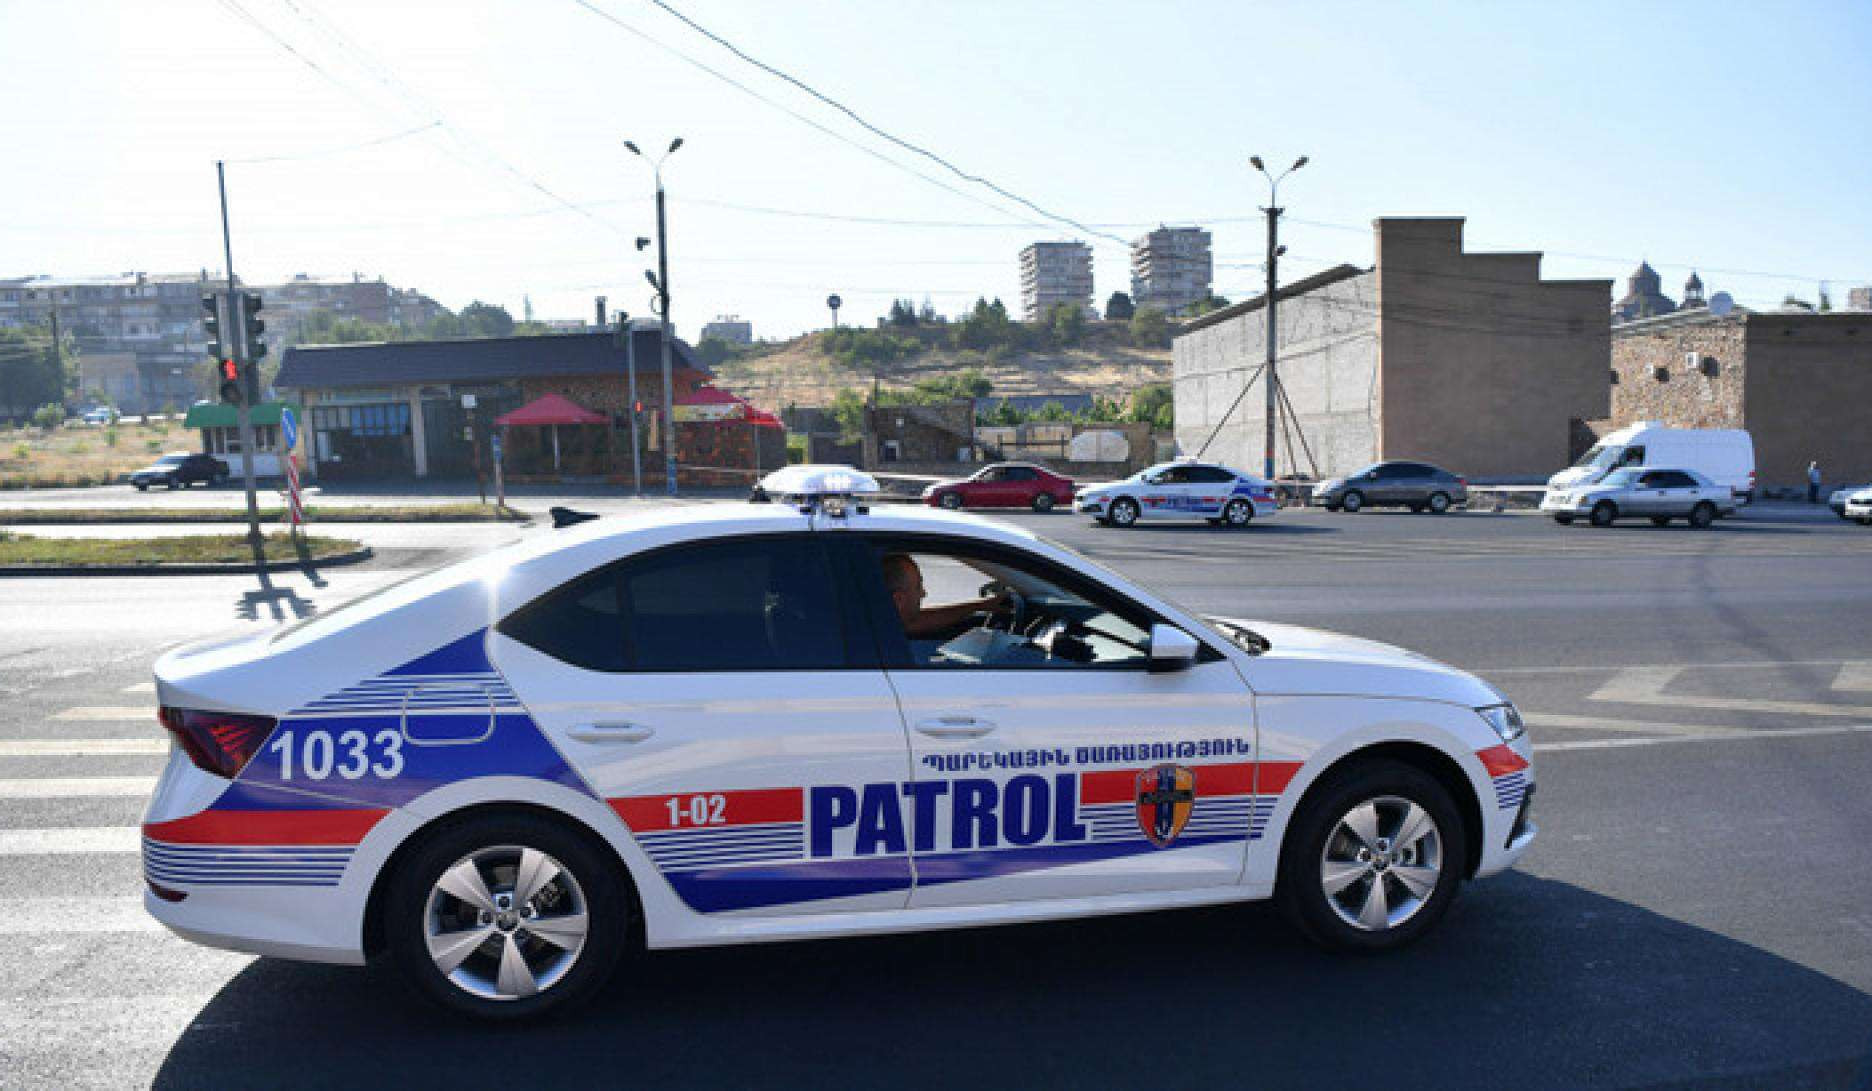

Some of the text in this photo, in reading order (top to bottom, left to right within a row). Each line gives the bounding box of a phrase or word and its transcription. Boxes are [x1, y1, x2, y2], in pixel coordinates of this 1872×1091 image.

[270, 730, 404, 780] 1033
[665, 794, 727, 826] 1-02
[810, 773, 1086, 857] PATROL
